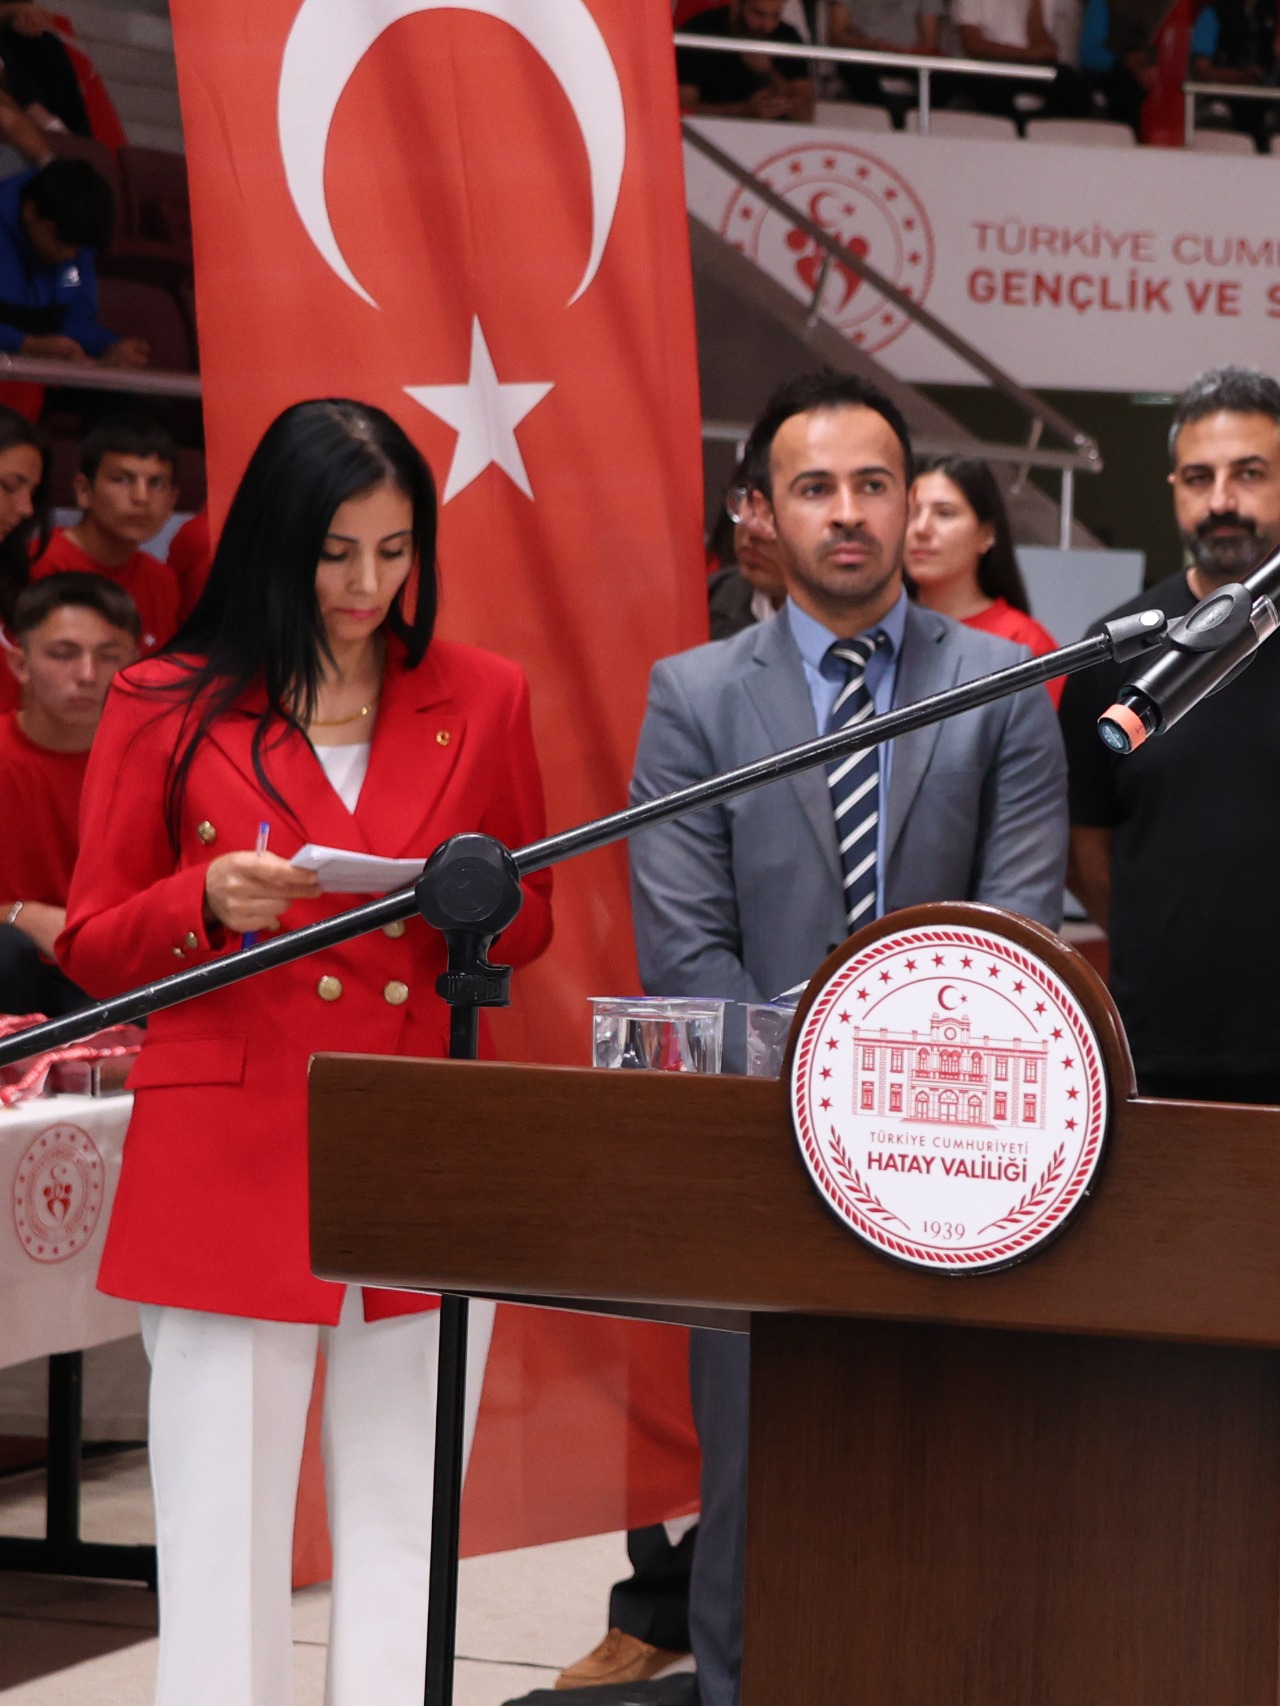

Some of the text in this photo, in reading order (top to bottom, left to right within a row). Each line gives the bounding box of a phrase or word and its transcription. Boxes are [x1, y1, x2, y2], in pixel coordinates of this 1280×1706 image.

[971, 217, 1157, 262] TÜRKİYE
[967, 267, 1171, 315] GENÇLİK
[1185, 278, 1242, 316] VE
[870, 1130, 1028, 1154] TÜRKİYE CUMHURİYETİ
[867, 1151, 1027, 1182] HATAY VALİLİĞİ
[923, 1221, 965, 1240] 1939
